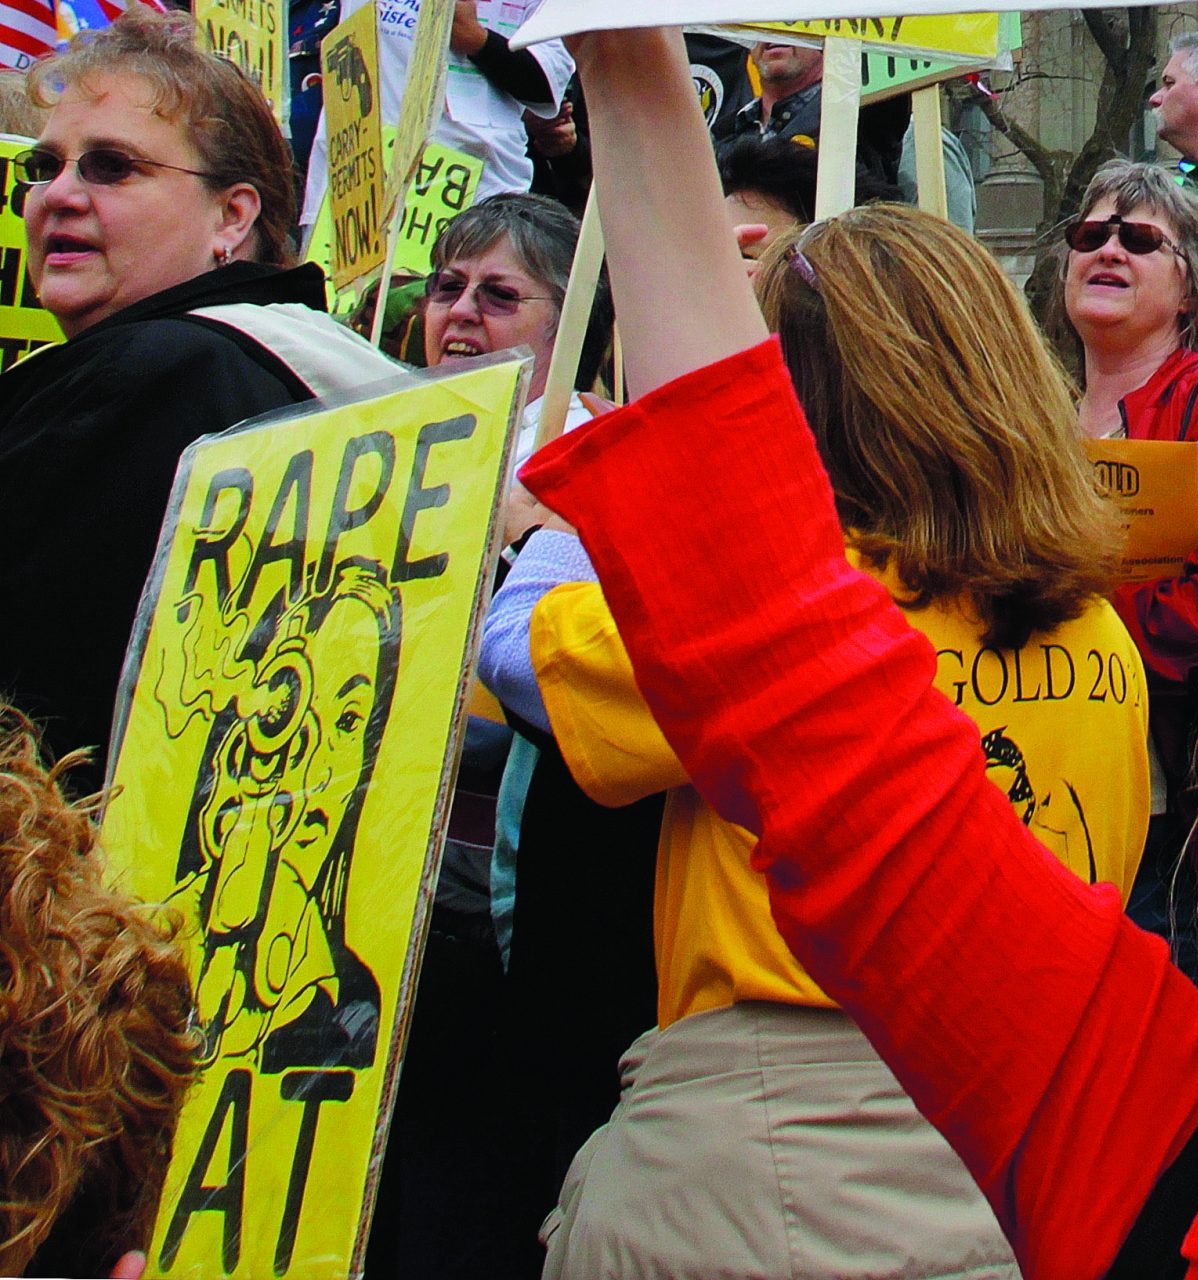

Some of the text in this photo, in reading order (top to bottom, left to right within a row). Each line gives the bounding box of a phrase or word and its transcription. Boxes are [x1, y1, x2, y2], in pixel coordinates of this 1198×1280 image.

[377, 1, 417, 29] iste
[332, 146, 377, 201] PERMITS
[335, 183, 380, 270] NOW!
[1092, 460, 1140, 498] OLD
[177, 413, 477, 624] RAPE
[936, 644, 1140, 708] GOLD 20
